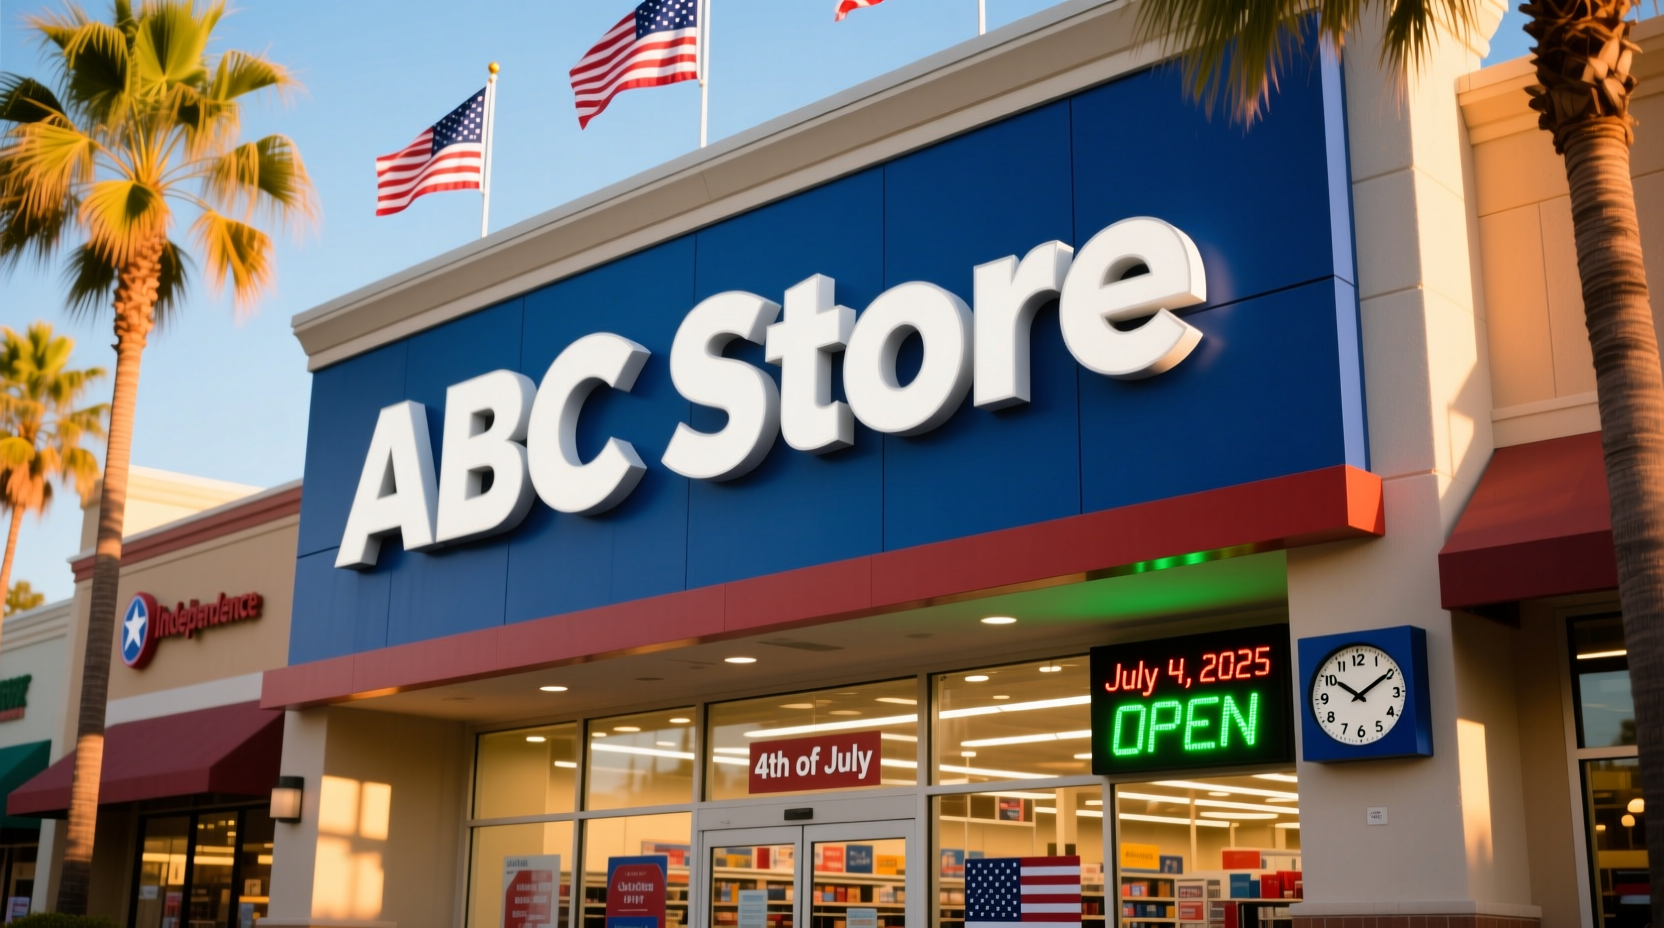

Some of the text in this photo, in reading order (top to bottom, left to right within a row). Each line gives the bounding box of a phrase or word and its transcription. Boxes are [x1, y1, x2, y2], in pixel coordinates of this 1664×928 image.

[334, 216, 1207, 569] ABC Store
[1337, 661, 1346, 672] 11
[1352, 653, 1365, 667] 12
[1105, 646, 1270, 696] July 4, 2025
[1325, 674, 1338, 686] 10
[1392, 686, 1401, 698] 3
[1320, 693, 1329, 705] 9
[1326, 711, 1335, 723] 8
[1386, 705, 1395, 718] 4
[1113, 692, 1258, 756] OPEN
[1341, 723, 1348, 735] 7
[1375, 720, 1384, 733] 5
[1357, 725, 1366, 738] 6
[754, 743, 873, 779] 4th of July
